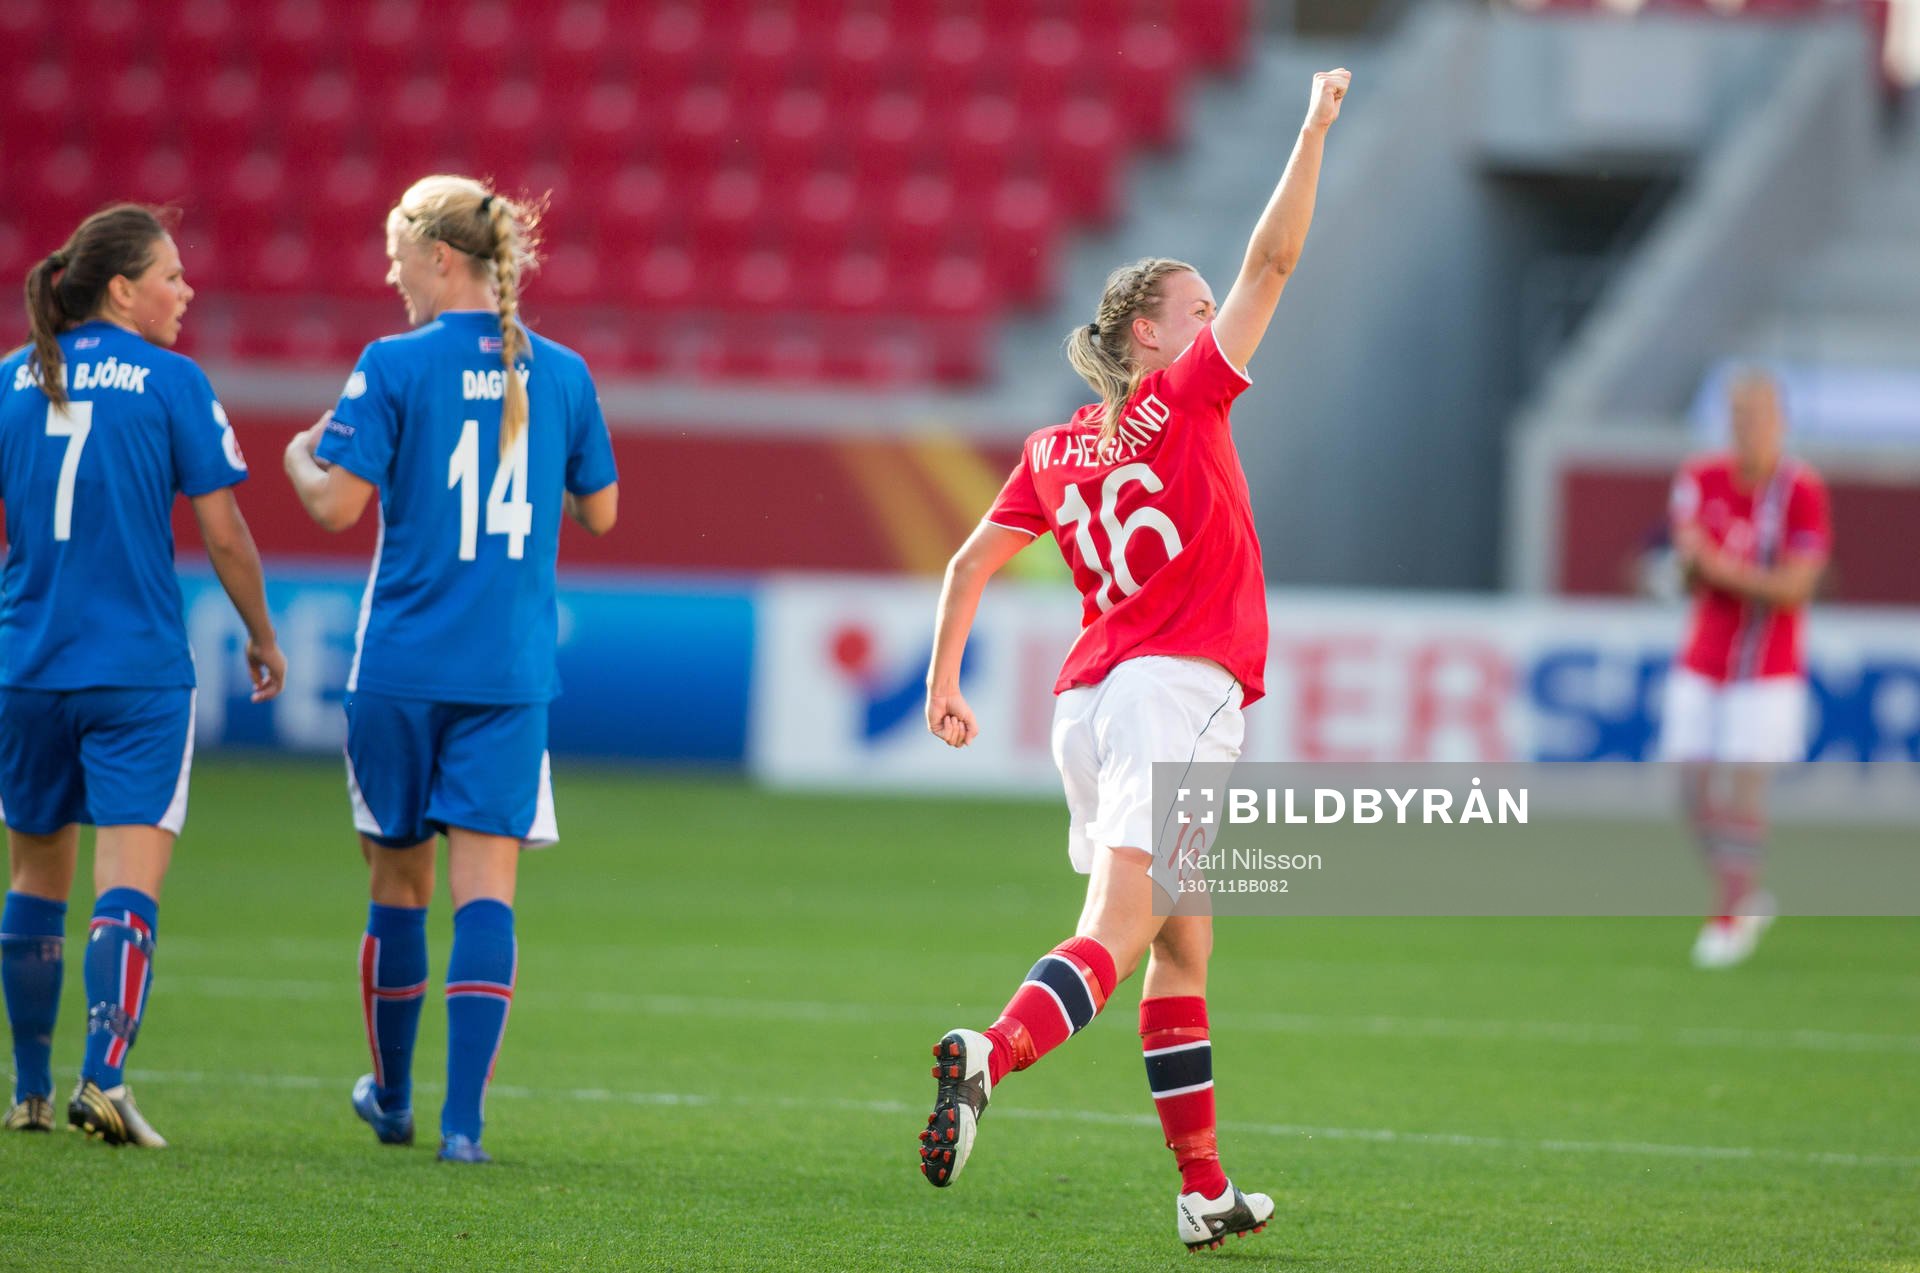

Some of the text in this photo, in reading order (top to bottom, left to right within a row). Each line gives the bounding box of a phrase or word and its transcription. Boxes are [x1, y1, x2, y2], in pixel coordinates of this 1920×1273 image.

[74, 356, 150, 394] BJÖRK
[45, 400, 94, 541] 7
[448, 419, 533, 561] 14
[1056, 461, 1184, 616] 16
[1181, 1203, 1201, 1232] umbro
